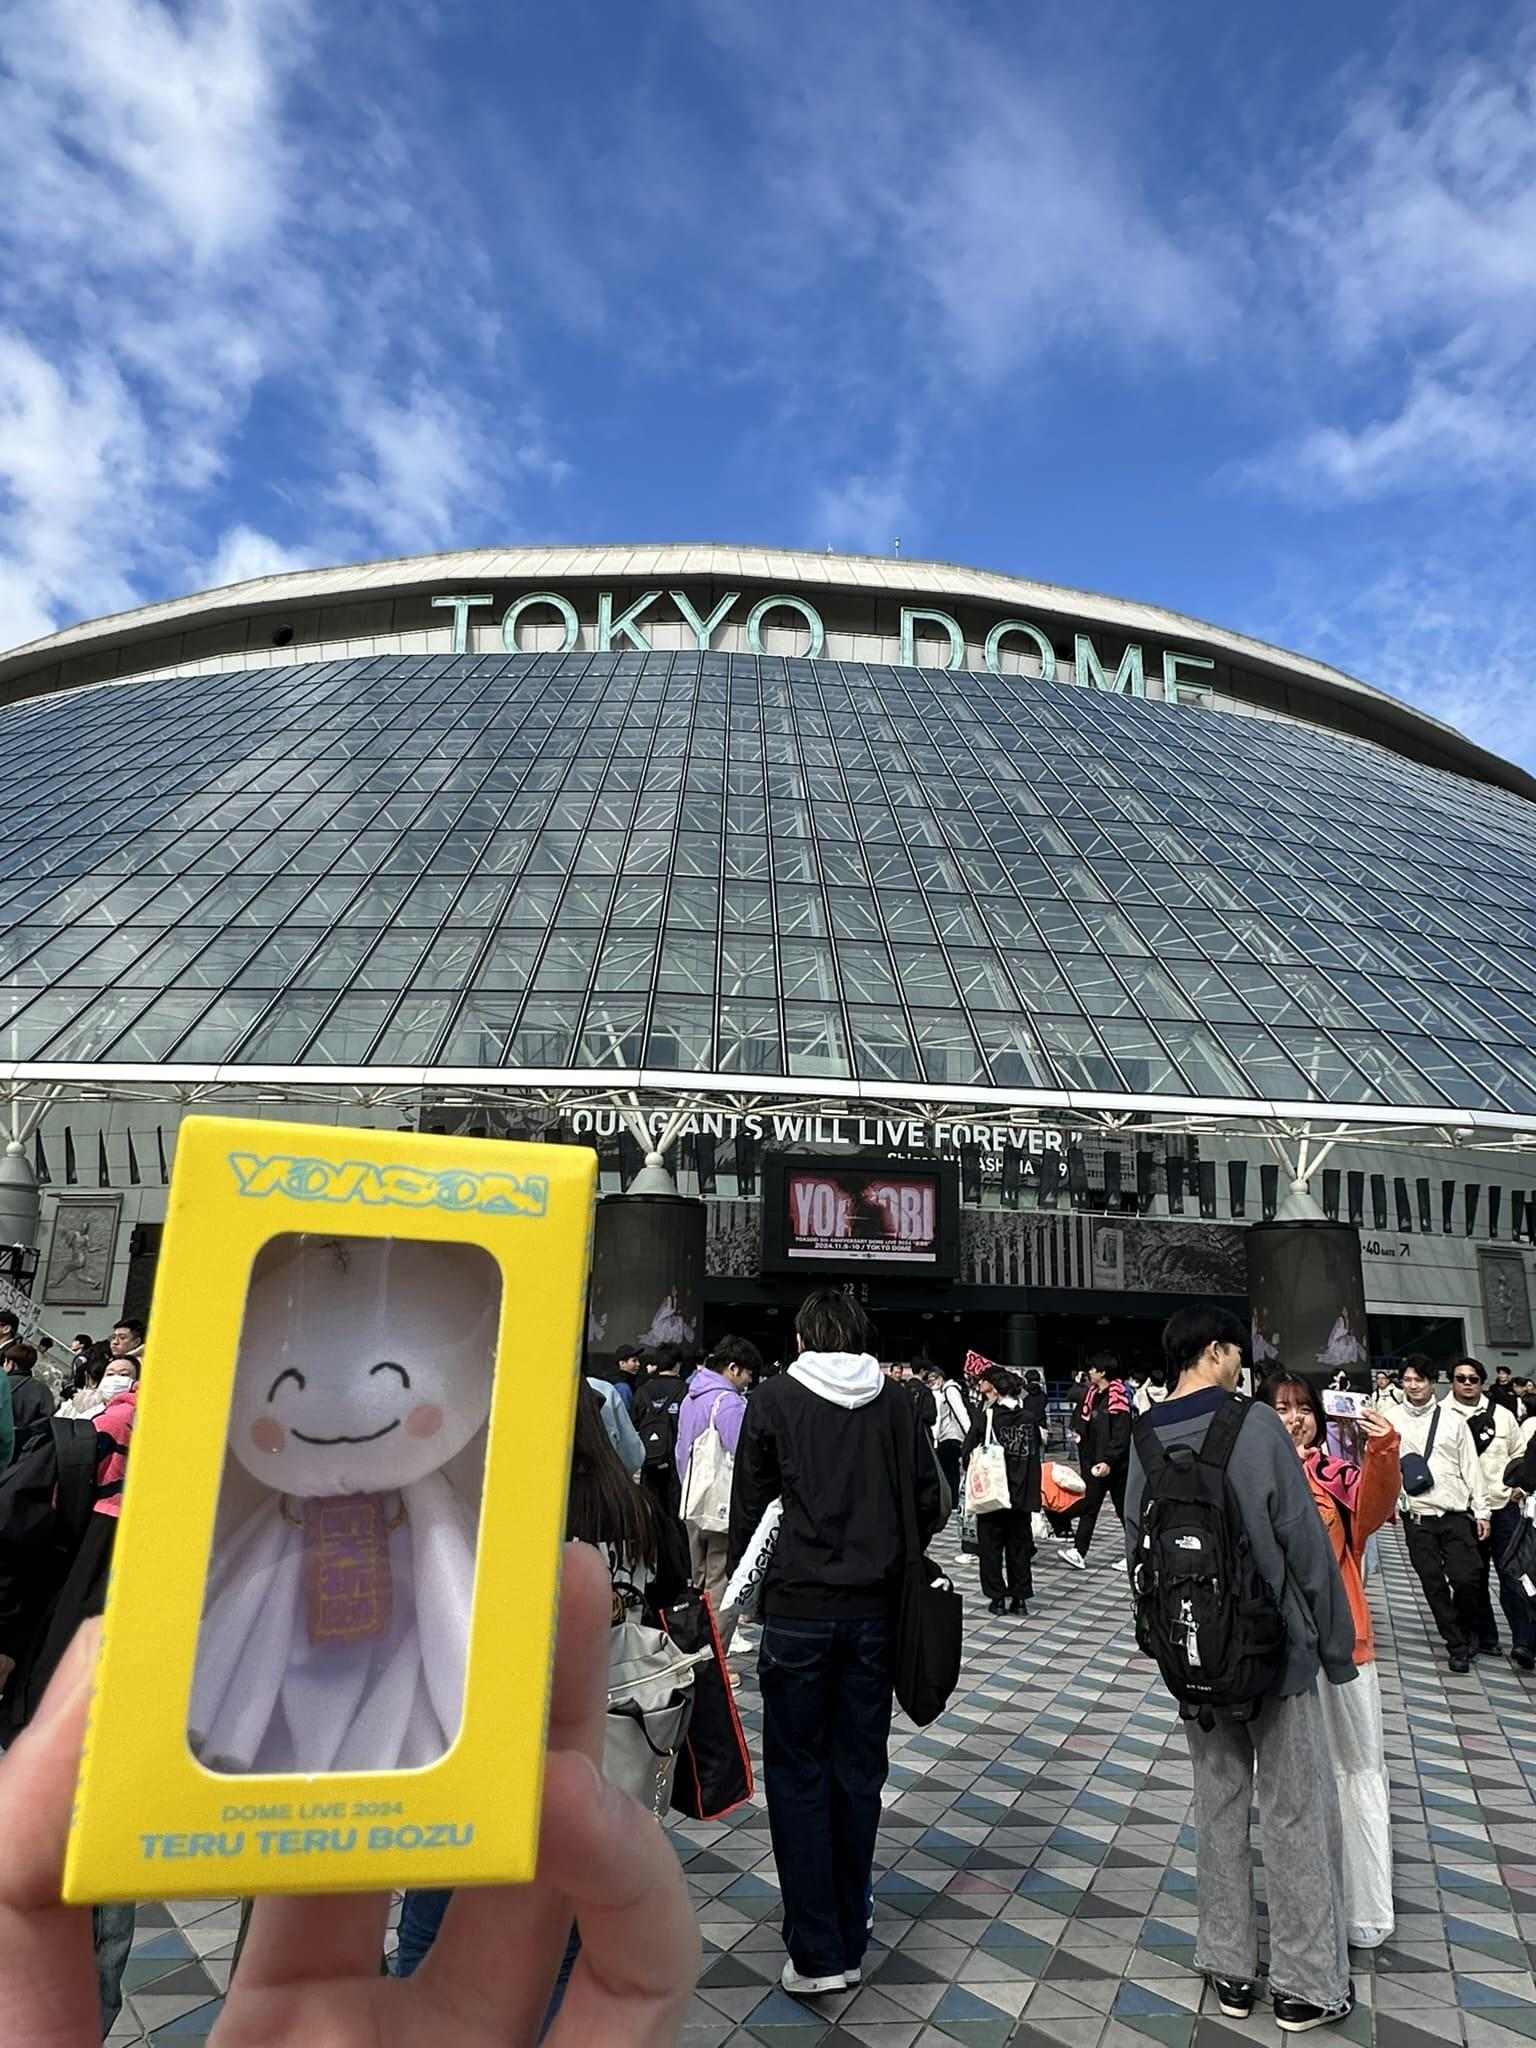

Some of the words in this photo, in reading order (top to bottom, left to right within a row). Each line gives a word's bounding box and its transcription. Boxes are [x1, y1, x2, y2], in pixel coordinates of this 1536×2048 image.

[431, 590, 824, 658] TOKYO
[900, 606, 1215, 705] DOME
[773, 1115, 849, 1143] WILL
[858, 1118, 924, 1147] LIVE
[221, 1803, 291, 1823] DOME
[299, 1802, 347, 1821] LIVE
[352, 1800, 403, 1819] 2024
[139, 1831, 245, 1859] TERU
[255, 1826, 358, 1857] TERU
[367, 1822, 475, 1851] BOZU
